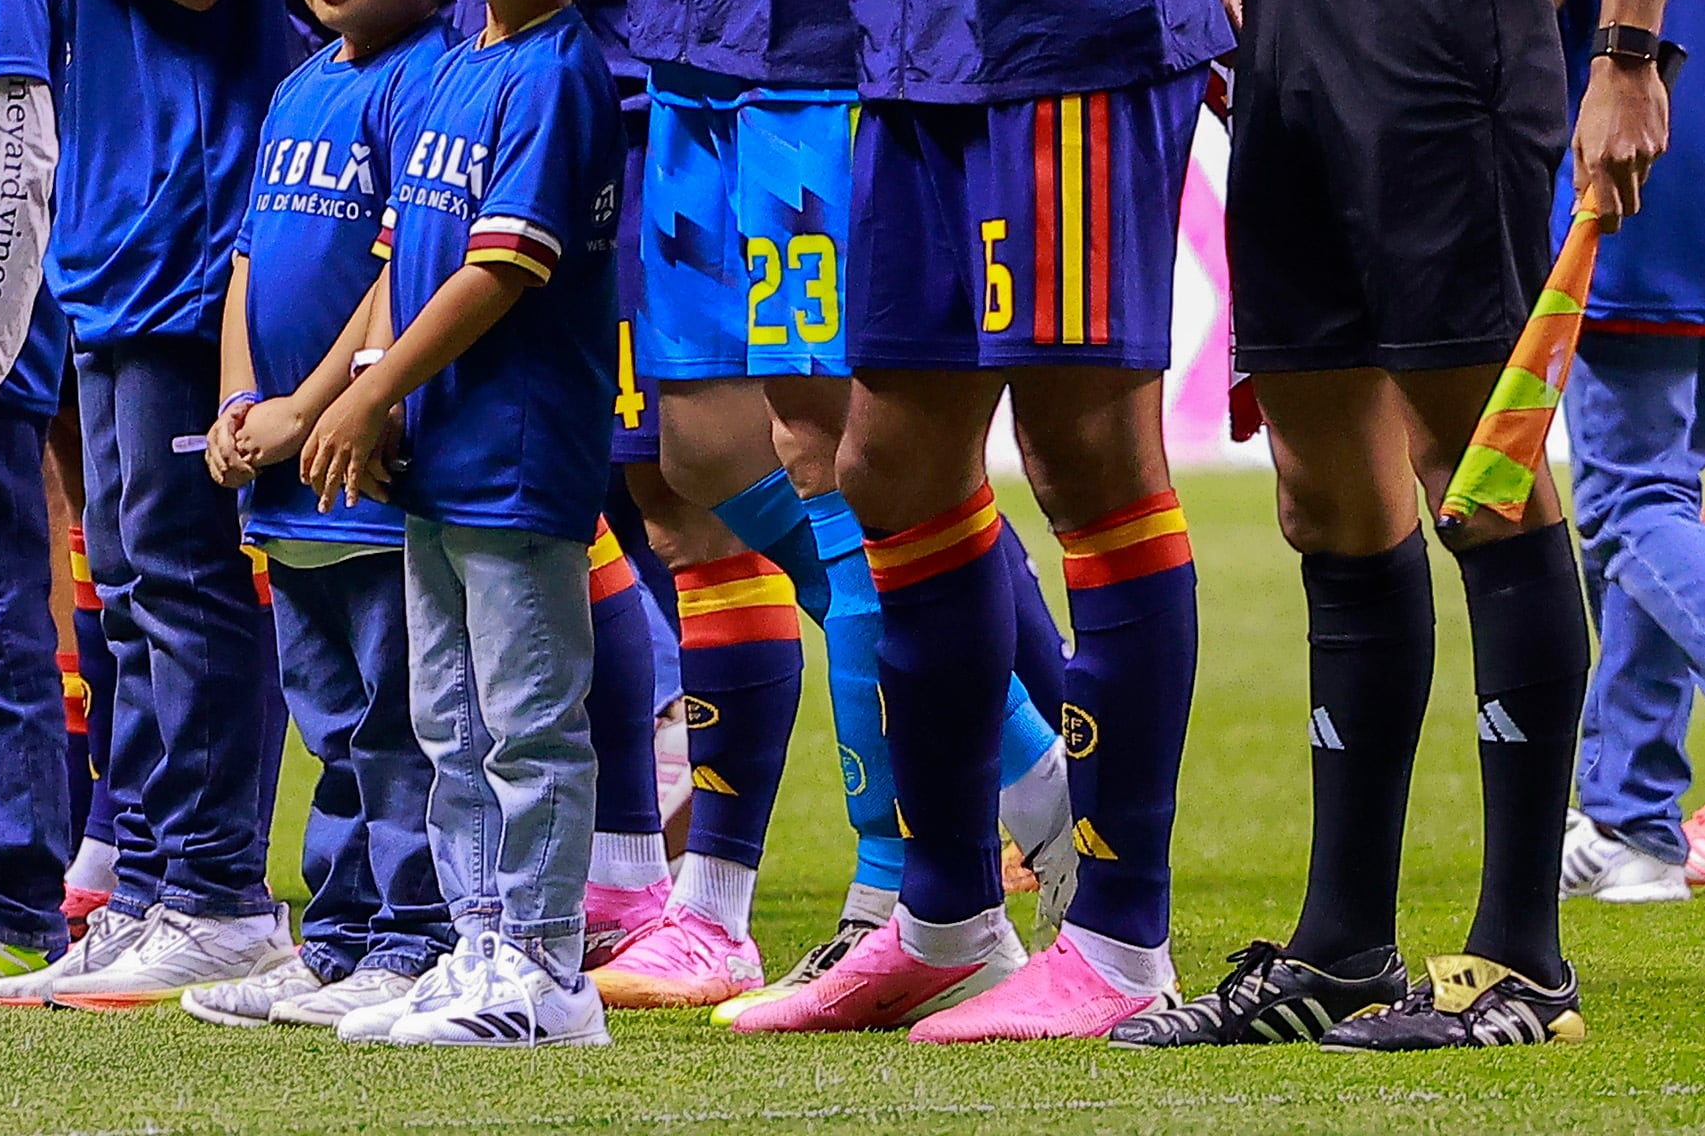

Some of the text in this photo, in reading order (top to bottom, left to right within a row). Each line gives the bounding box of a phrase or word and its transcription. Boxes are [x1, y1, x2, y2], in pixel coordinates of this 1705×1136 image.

[262, 138, 374, 195] EBLA
[291, 192, 359, 220] MÉXICO
[748, 233, 839, 345] 23
